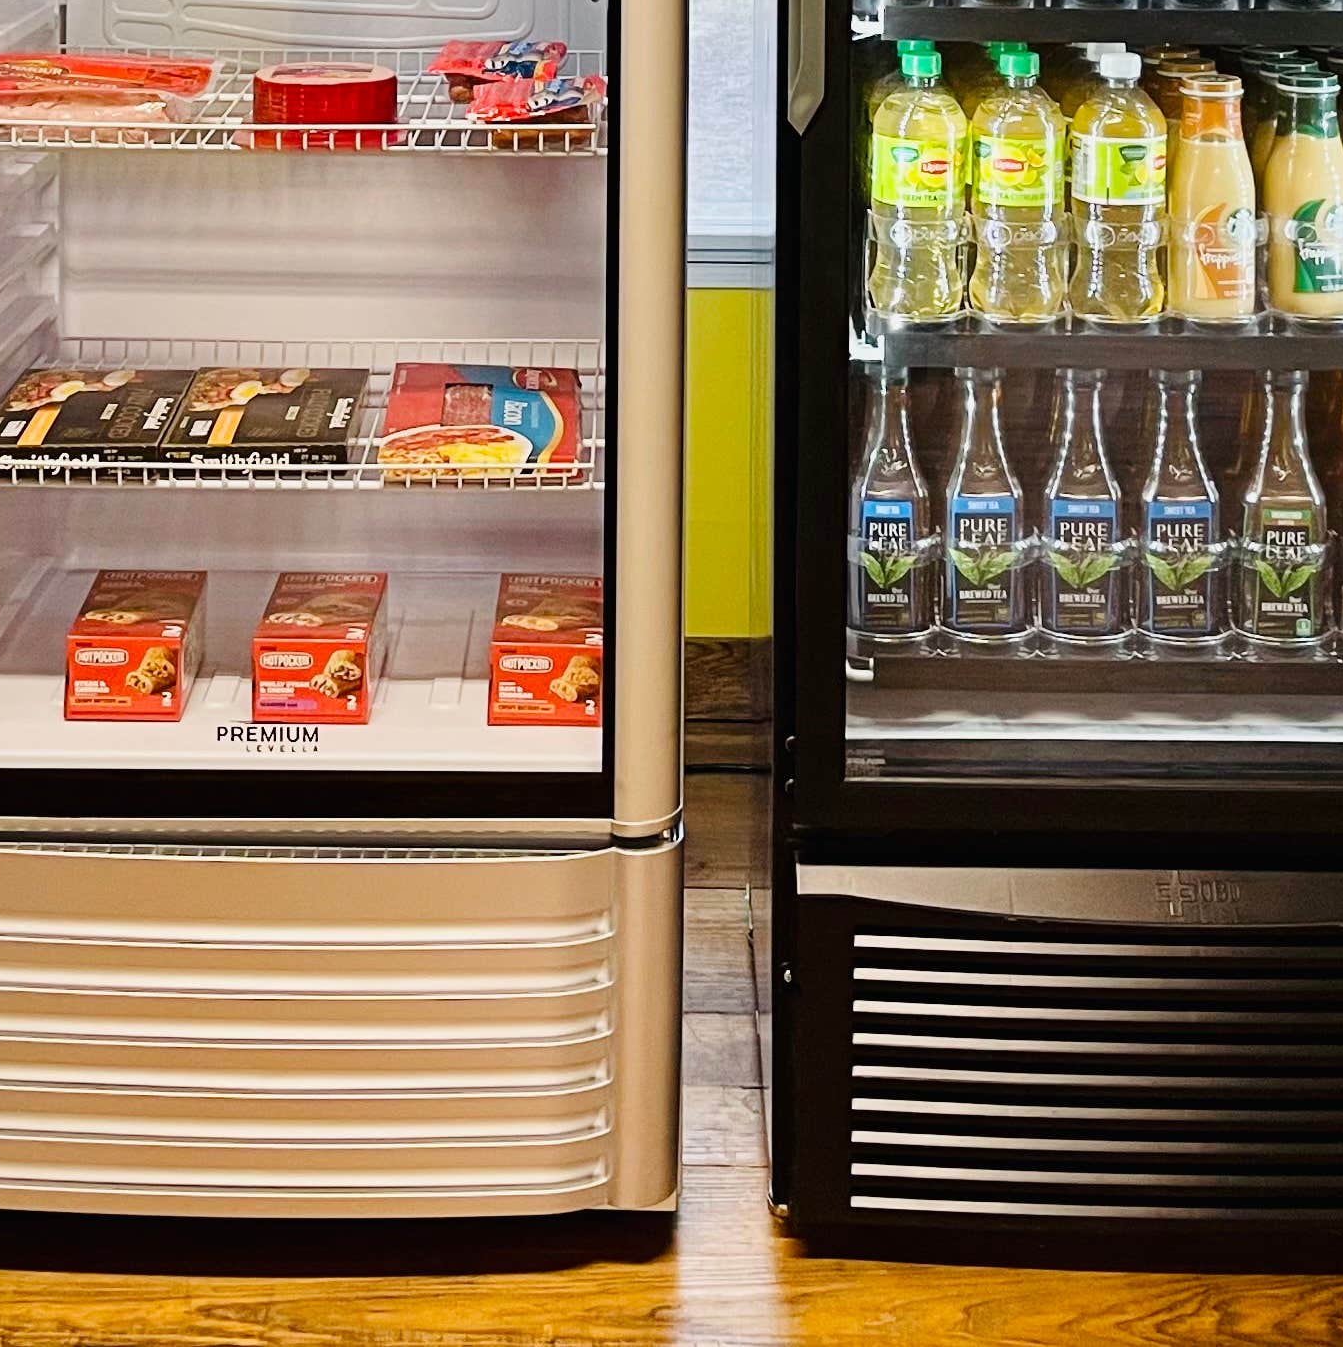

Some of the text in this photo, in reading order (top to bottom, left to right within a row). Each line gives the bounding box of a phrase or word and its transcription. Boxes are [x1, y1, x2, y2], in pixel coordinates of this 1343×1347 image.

[869, 522, 907, 538] PURE
[960, 518, 1007, 533] PURE
[1060, 522, 1107, 537] PURE
[1156, 523, 1204, 537] PURE
[1266, 530, 1306, 546] PURE
[216, 725, 319, 743] PREMIUM
[246, 744, 318, 753] LEVELLA
